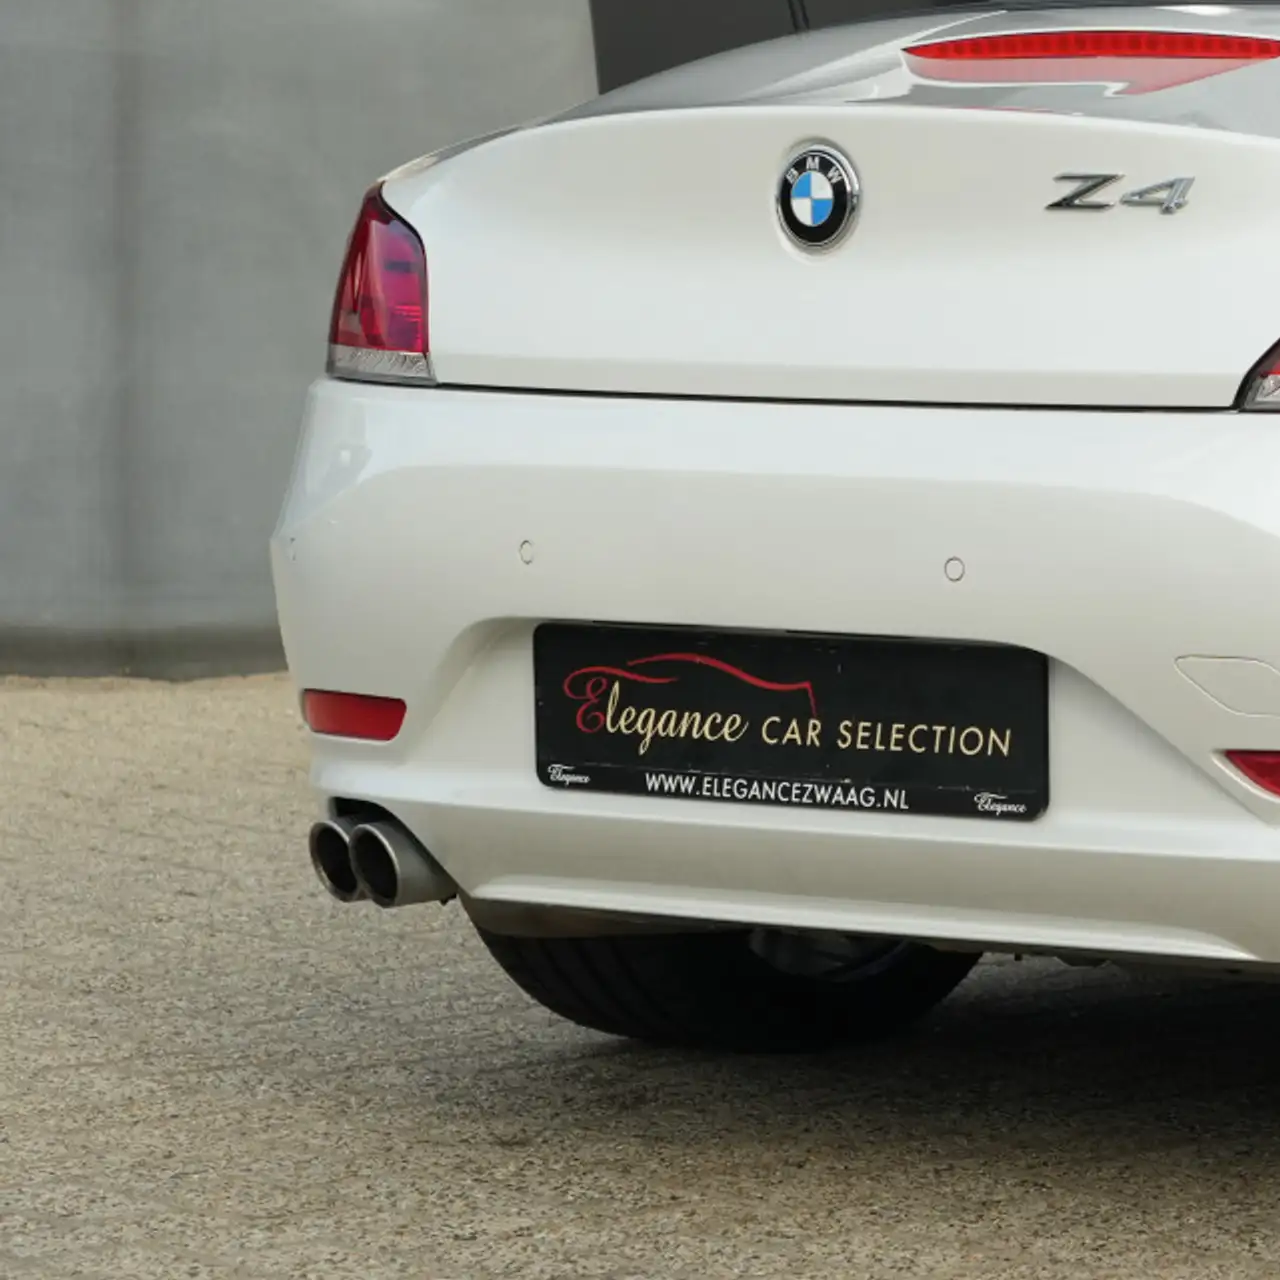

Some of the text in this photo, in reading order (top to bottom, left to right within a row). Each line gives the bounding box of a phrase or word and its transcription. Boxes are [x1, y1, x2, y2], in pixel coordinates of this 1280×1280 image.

[786, 154, 843, 184] BMW
[1044, 172, 1196, 215] Z4
[564, 667, 1011, 757] Elegance CAR SELECTION
[645, 772, 910, 809] WWW.ELEGANCEZWAAG.NL
